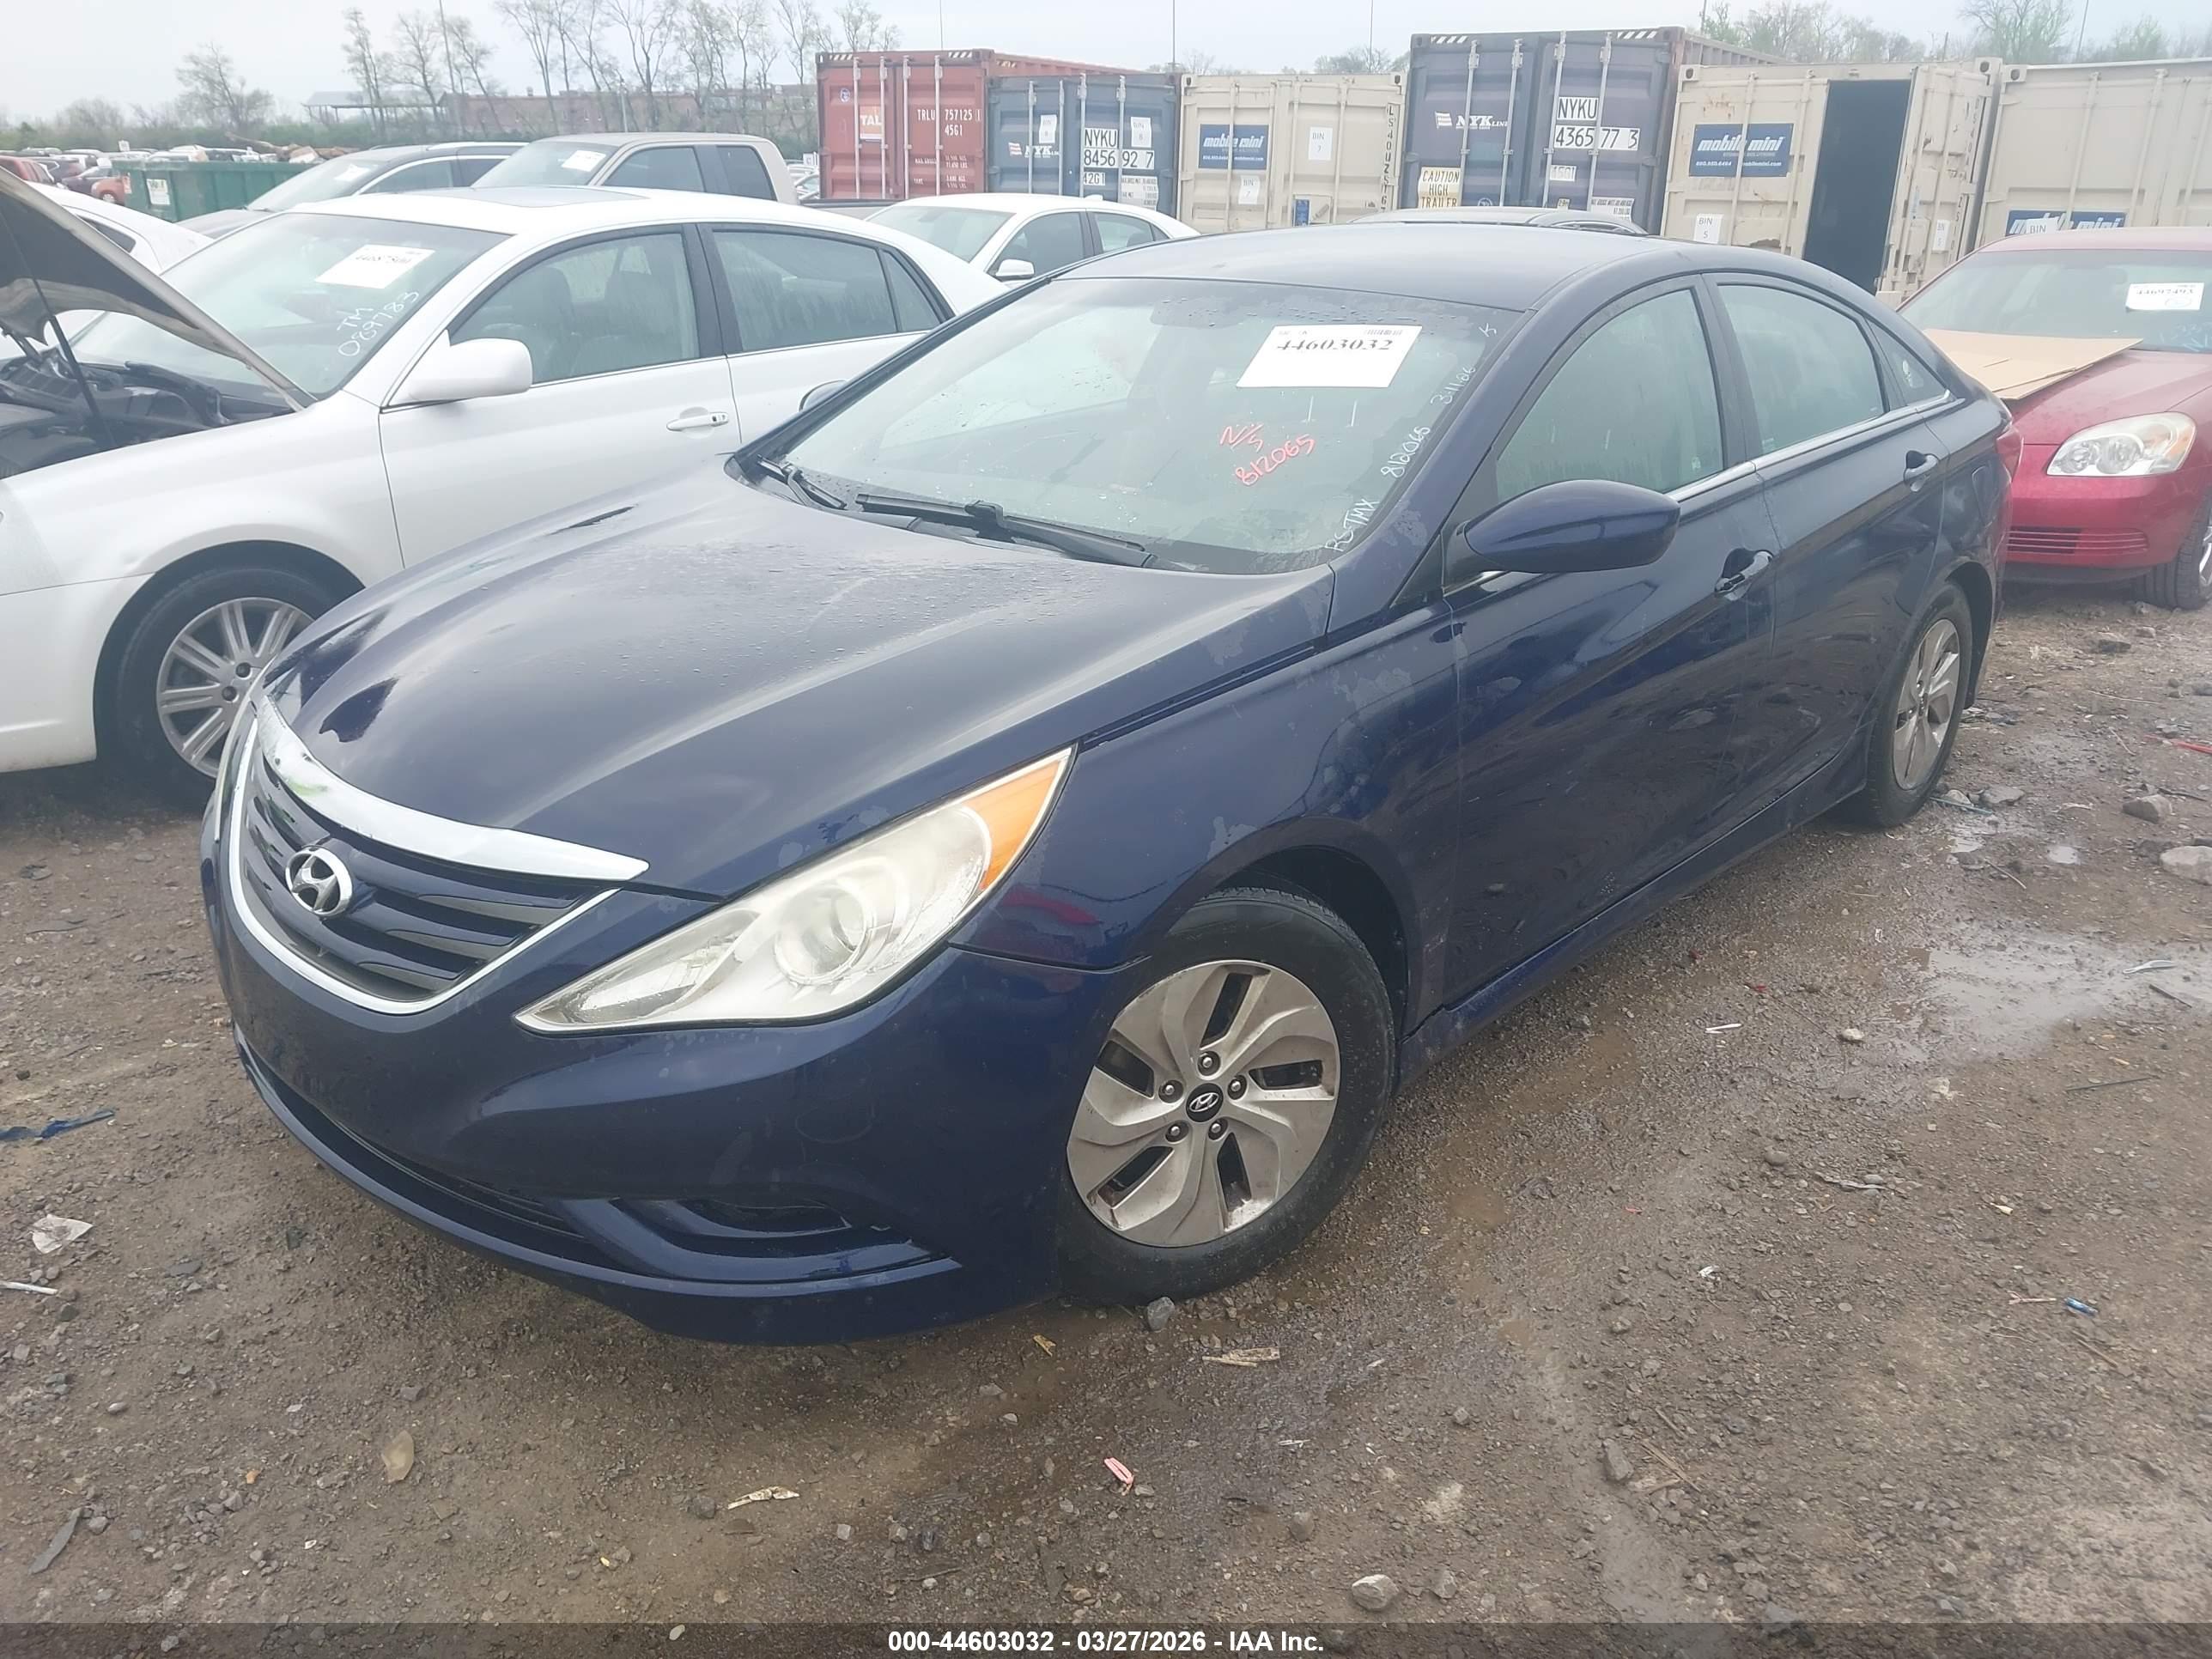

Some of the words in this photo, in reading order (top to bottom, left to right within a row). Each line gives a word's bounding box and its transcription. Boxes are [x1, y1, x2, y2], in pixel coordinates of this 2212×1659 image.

[917, 109, 936, 121] TRLU
[945, 109, 972, 121] 757125
[1558, 98, 1598, 119] NYKU
[1084, 129, 1116, 148] NYKU
[1747, 137, 1784, 152] mini
[1422, 170, 1460, 184] CAUTION
[1428, 183, 1449, 197] HIGH
[1698, 217, 1713, 226] BIN
[1703, 231, 1709, 240] 5
[2030, 224, 2046, 234] BIN
[1277, 338, 1393, 350] 44603032
[1236, 434, 1316, 486] 812065
